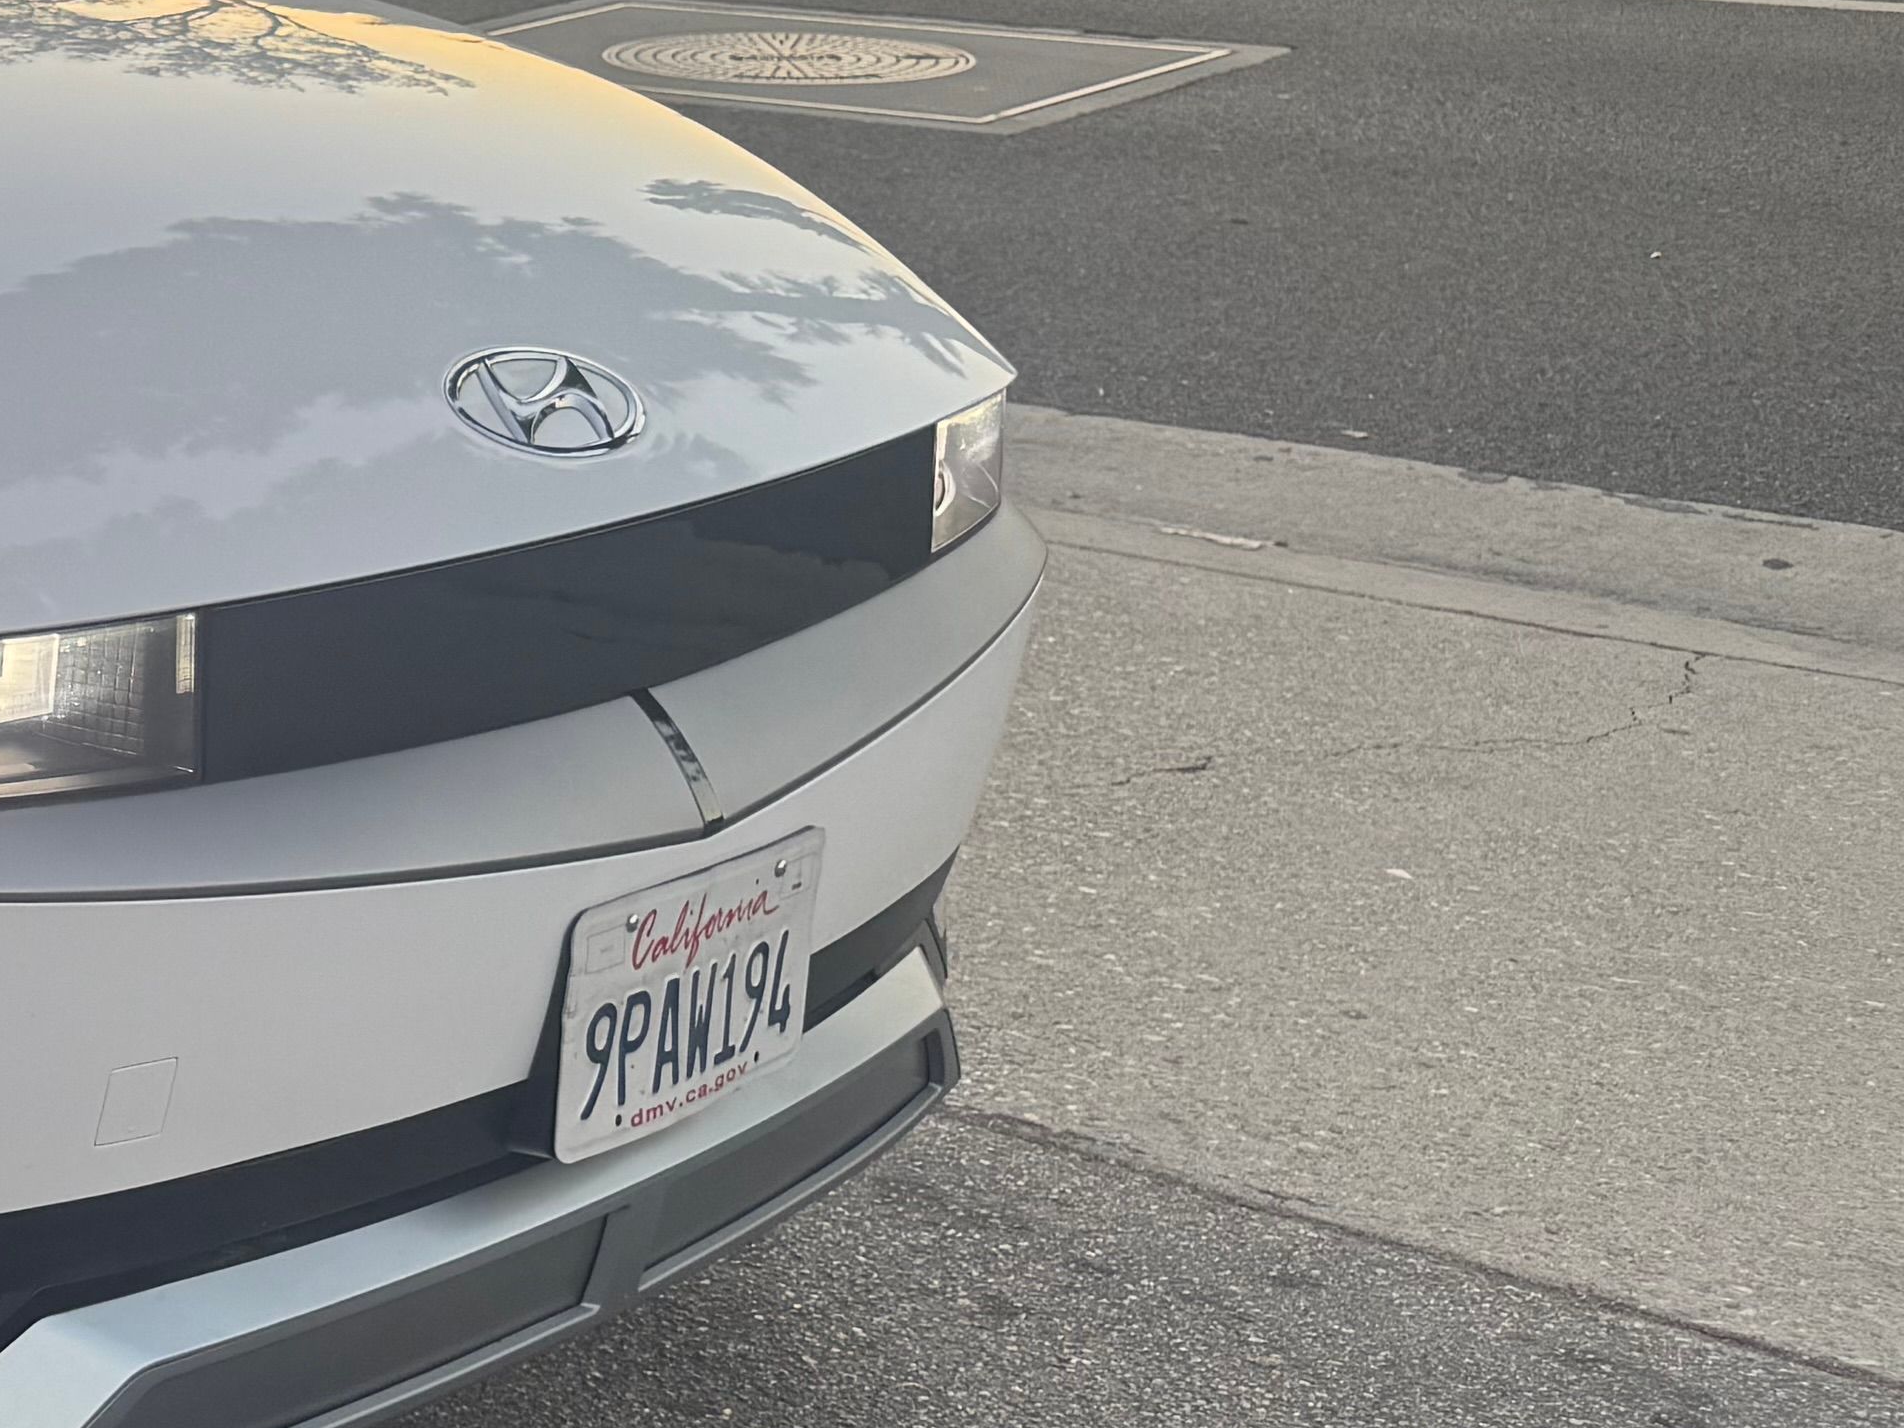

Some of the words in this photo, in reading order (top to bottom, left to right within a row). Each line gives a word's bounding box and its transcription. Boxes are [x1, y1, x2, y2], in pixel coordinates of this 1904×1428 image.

[631, 890, 780, 971] California
[579, 928, 791, 1121] 9PAW194
[630, 1060, 748, 1128] dmv.ca.gov
